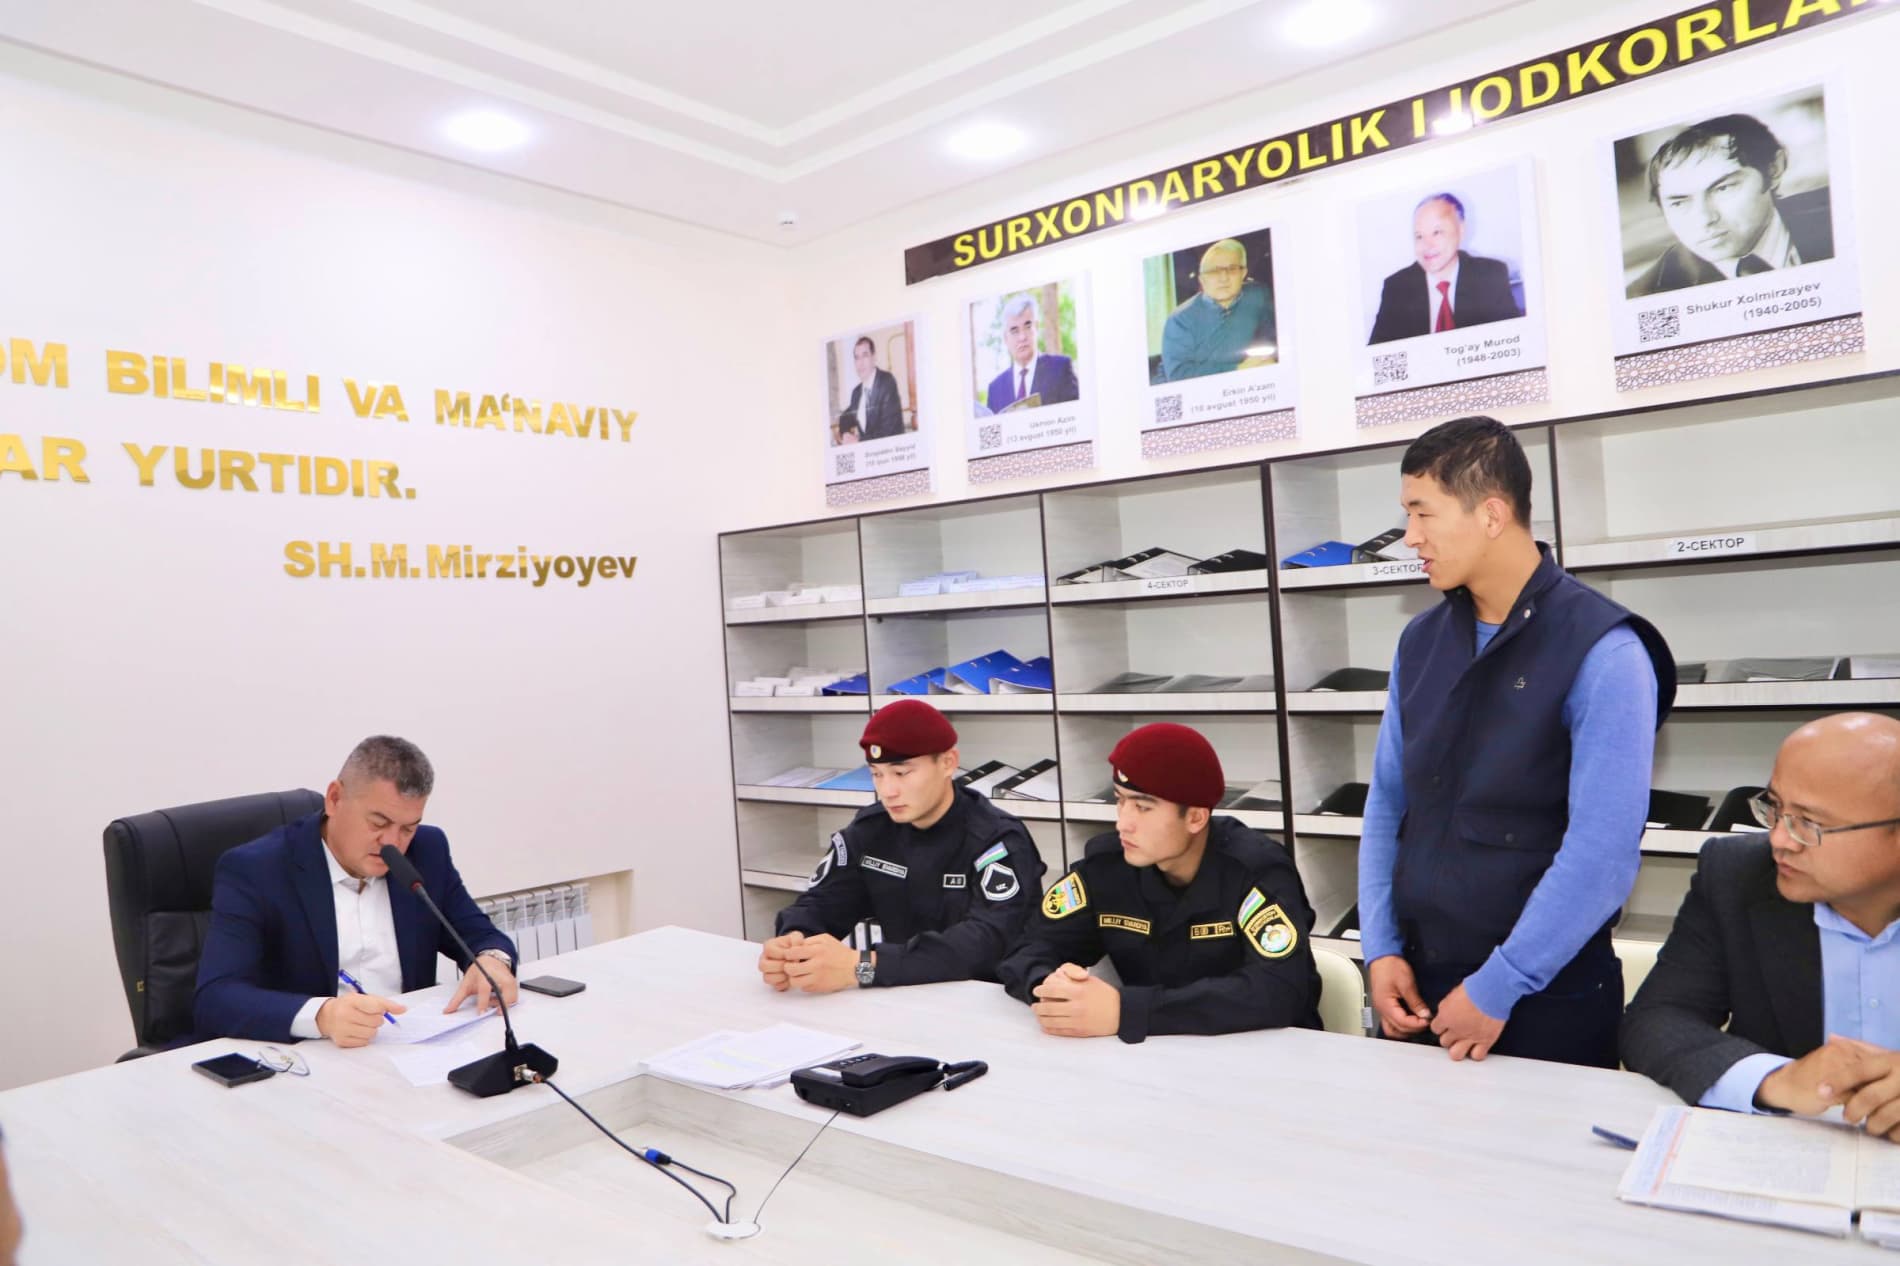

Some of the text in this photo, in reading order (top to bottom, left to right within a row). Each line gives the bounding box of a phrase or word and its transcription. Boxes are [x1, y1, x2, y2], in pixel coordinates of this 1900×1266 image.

[952, 108, 1391, 269] SURXONDARYOLIK
[1686, 282, 1821, 315] Shukur Xolmirzayev
[1743, 296, 1822, 320] (1940-2005)
[1484, 335, 1521, 348] Murod
[106, 349, 321, 412] BILIMLI
[343, 378, 410, 422] VA
[122, 442, 417, 500] YURTIDIR.
[1677, 537, 1745, 552] 2-СЕКТОР
[283, 540, 638, 588] SH.M.Mirziyoyev
[1147, 579, 1189, 589] 4-СЕКТОР
